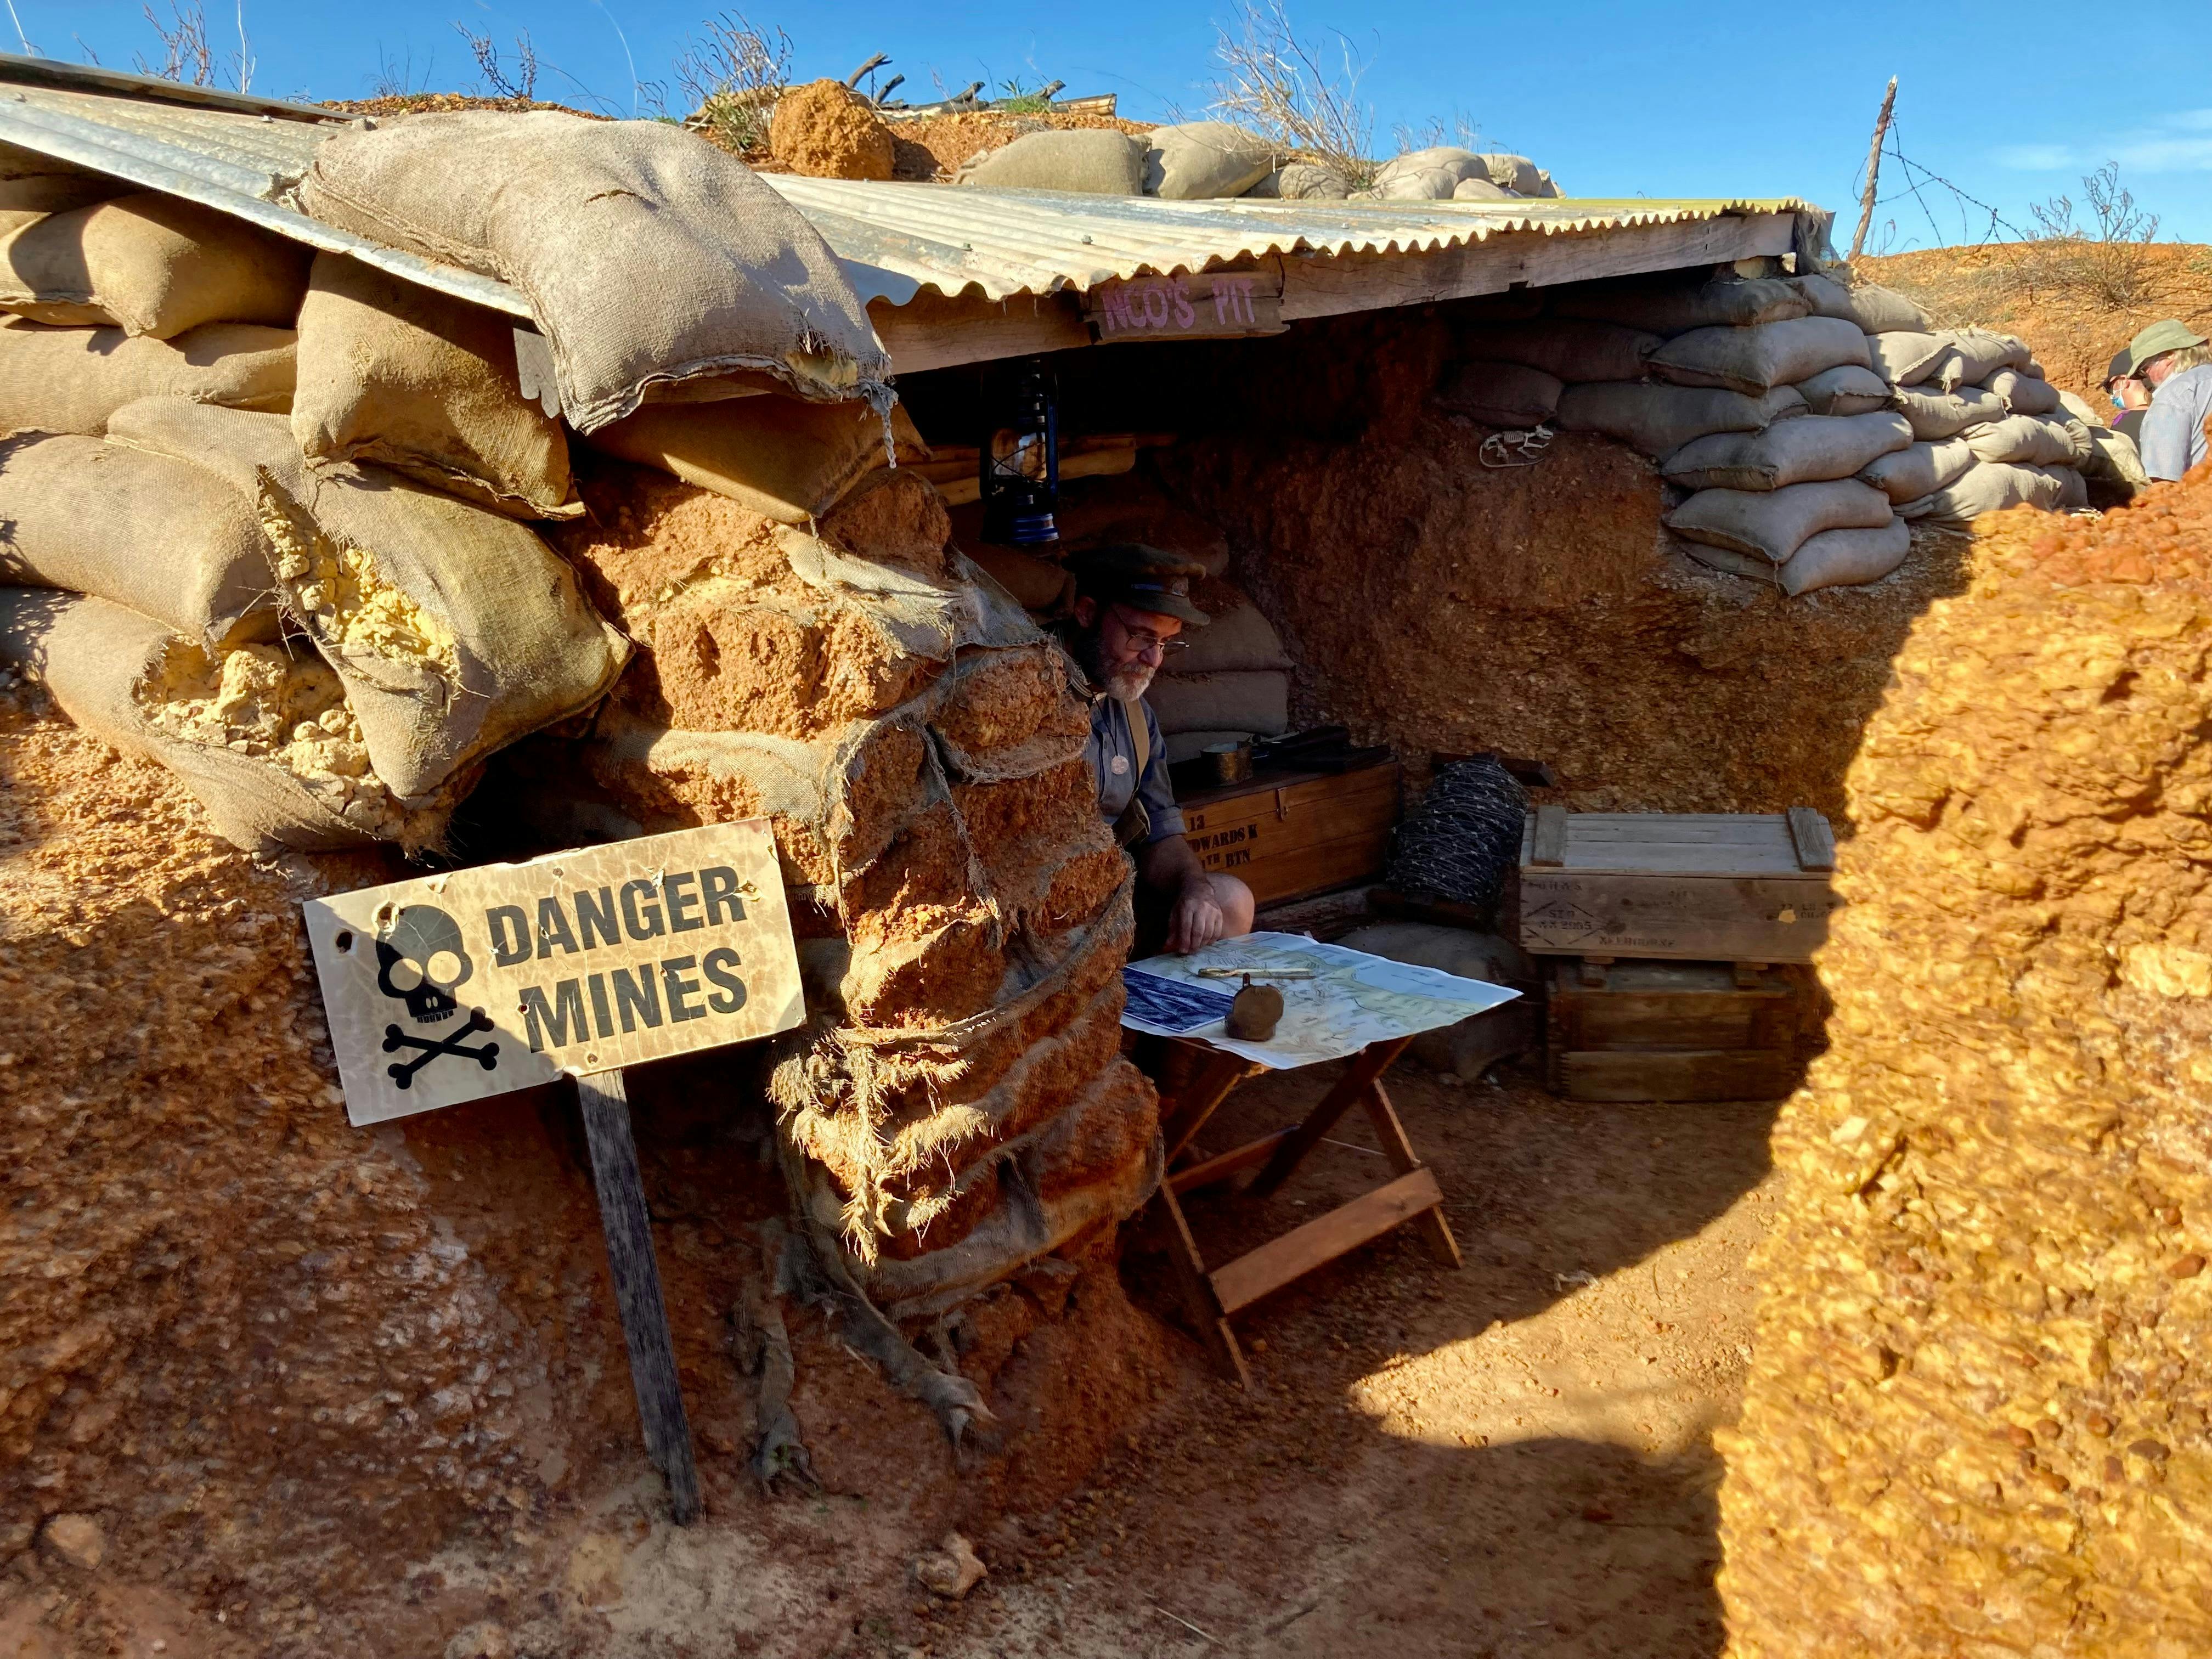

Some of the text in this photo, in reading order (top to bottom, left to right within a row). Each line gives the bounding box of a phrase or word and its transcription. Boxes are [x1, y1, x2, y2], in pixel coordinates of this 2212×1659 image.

[1211, 279, 1255, 325] PIT
[1225, 848, 1251, 867] BTN
[485, 865, 748, 968] DANGER
[517, 947, 748, 1054] MINES
